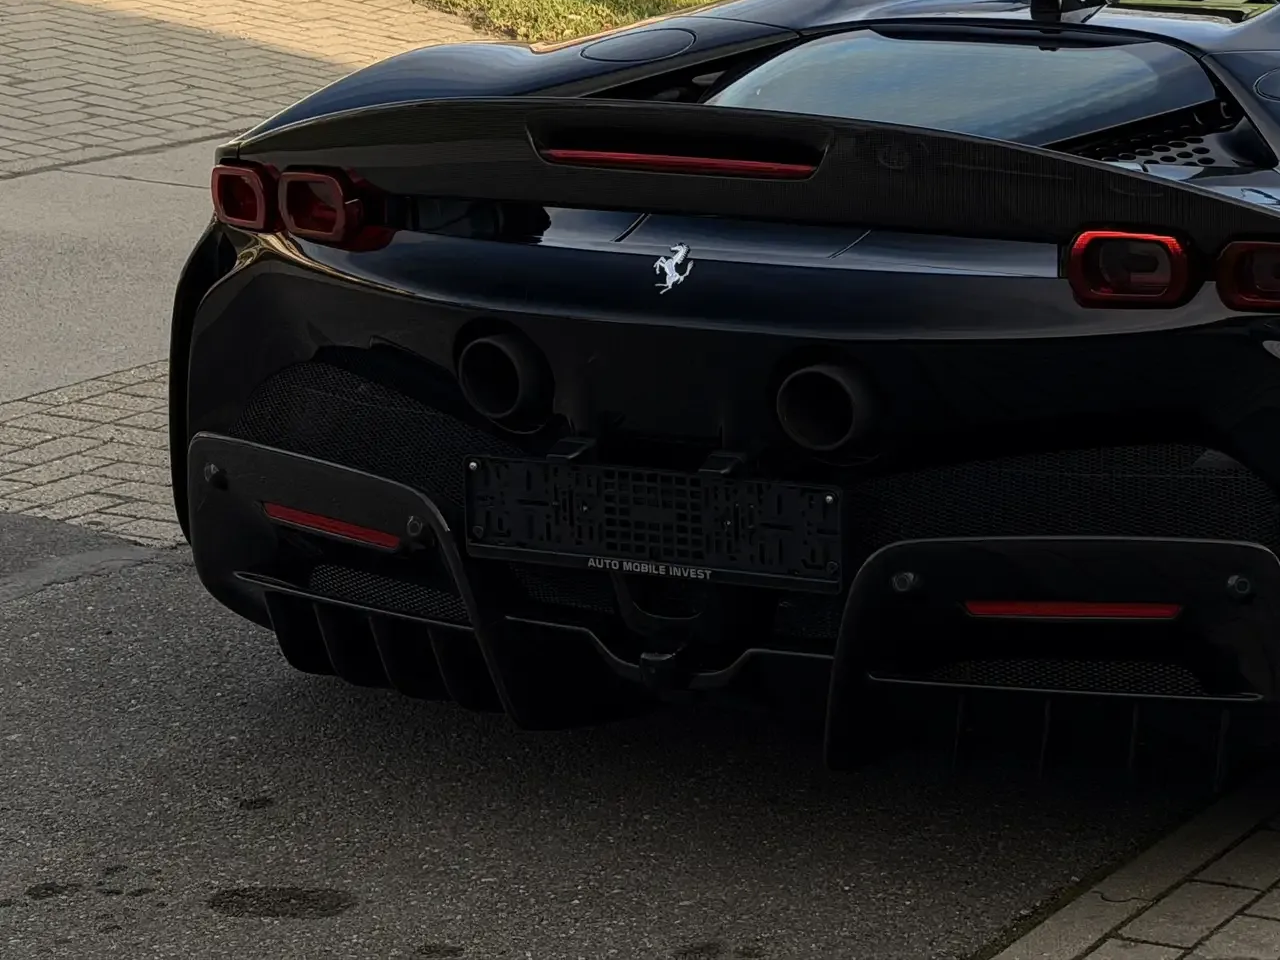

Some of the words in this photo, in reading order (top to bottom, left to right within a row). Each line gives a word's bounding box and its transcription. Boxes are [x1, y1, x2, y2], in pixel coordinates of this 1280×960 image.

[588, 558, 619, 570] AUTO
[623, 561, 666, 575] MOBILE
[669, 566, 712, 580] INVEST
